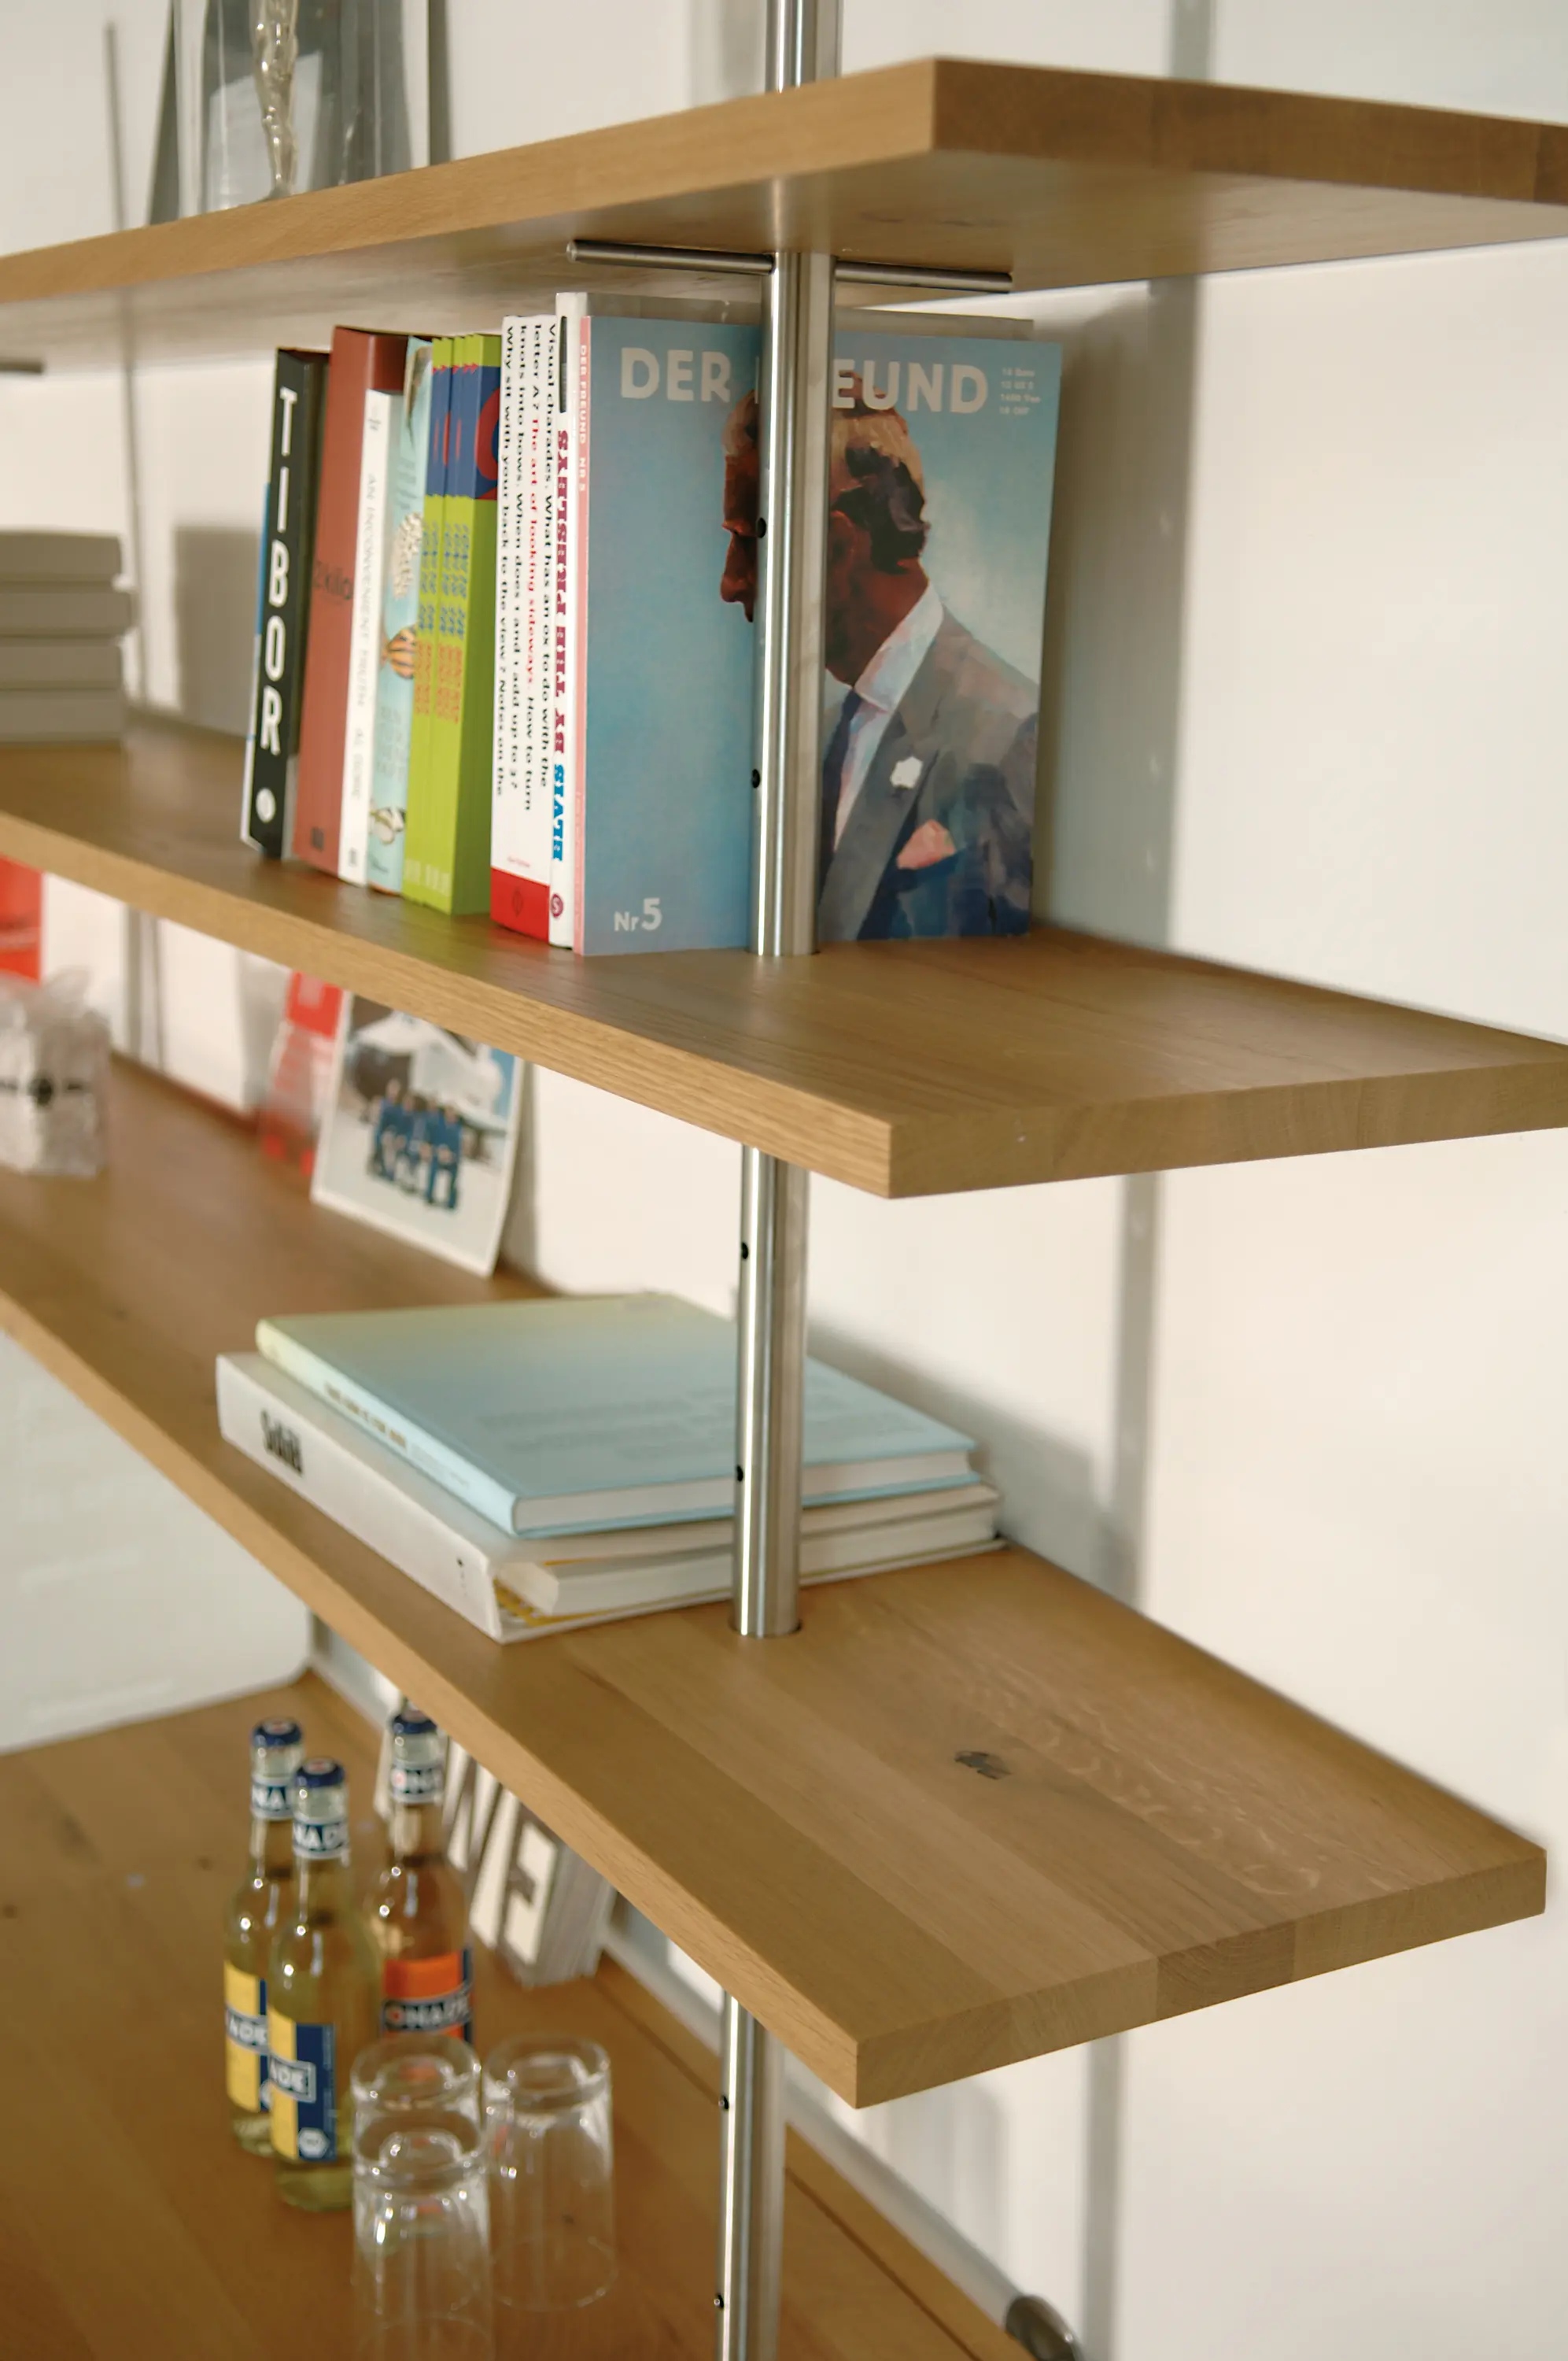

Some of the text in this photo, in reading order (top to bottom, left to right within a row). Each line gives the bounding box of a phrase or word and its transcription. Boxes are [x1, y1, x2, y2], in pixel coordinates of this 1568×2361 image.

[504, 325, 513, 369] Why
[621, 347, 989, 414] DER EUND
[544, 394, 554, 488] charades.
[579, 456, 586, 478] NR
[530, 492, 537, 512] of
[501, 556, 507, 575] to
[528, 520, 537, 592] looking
[260, 386, 297, 756] TIBOR
[544, 594, 549, 618] an
[526, 599, 536, 689] sideways.
[543, 624, 548, 645] ox
[552, 430, 568, 861] ELVIS BY THE PRESLEYS
[543, 652, 550, 672] to
[543, 678, 550, 702] do
[511, 715, 518, 738] up
[497, 737, 503, 760] on
[511, 745, 518, 763] to
[526, 745, 533, 763] to
